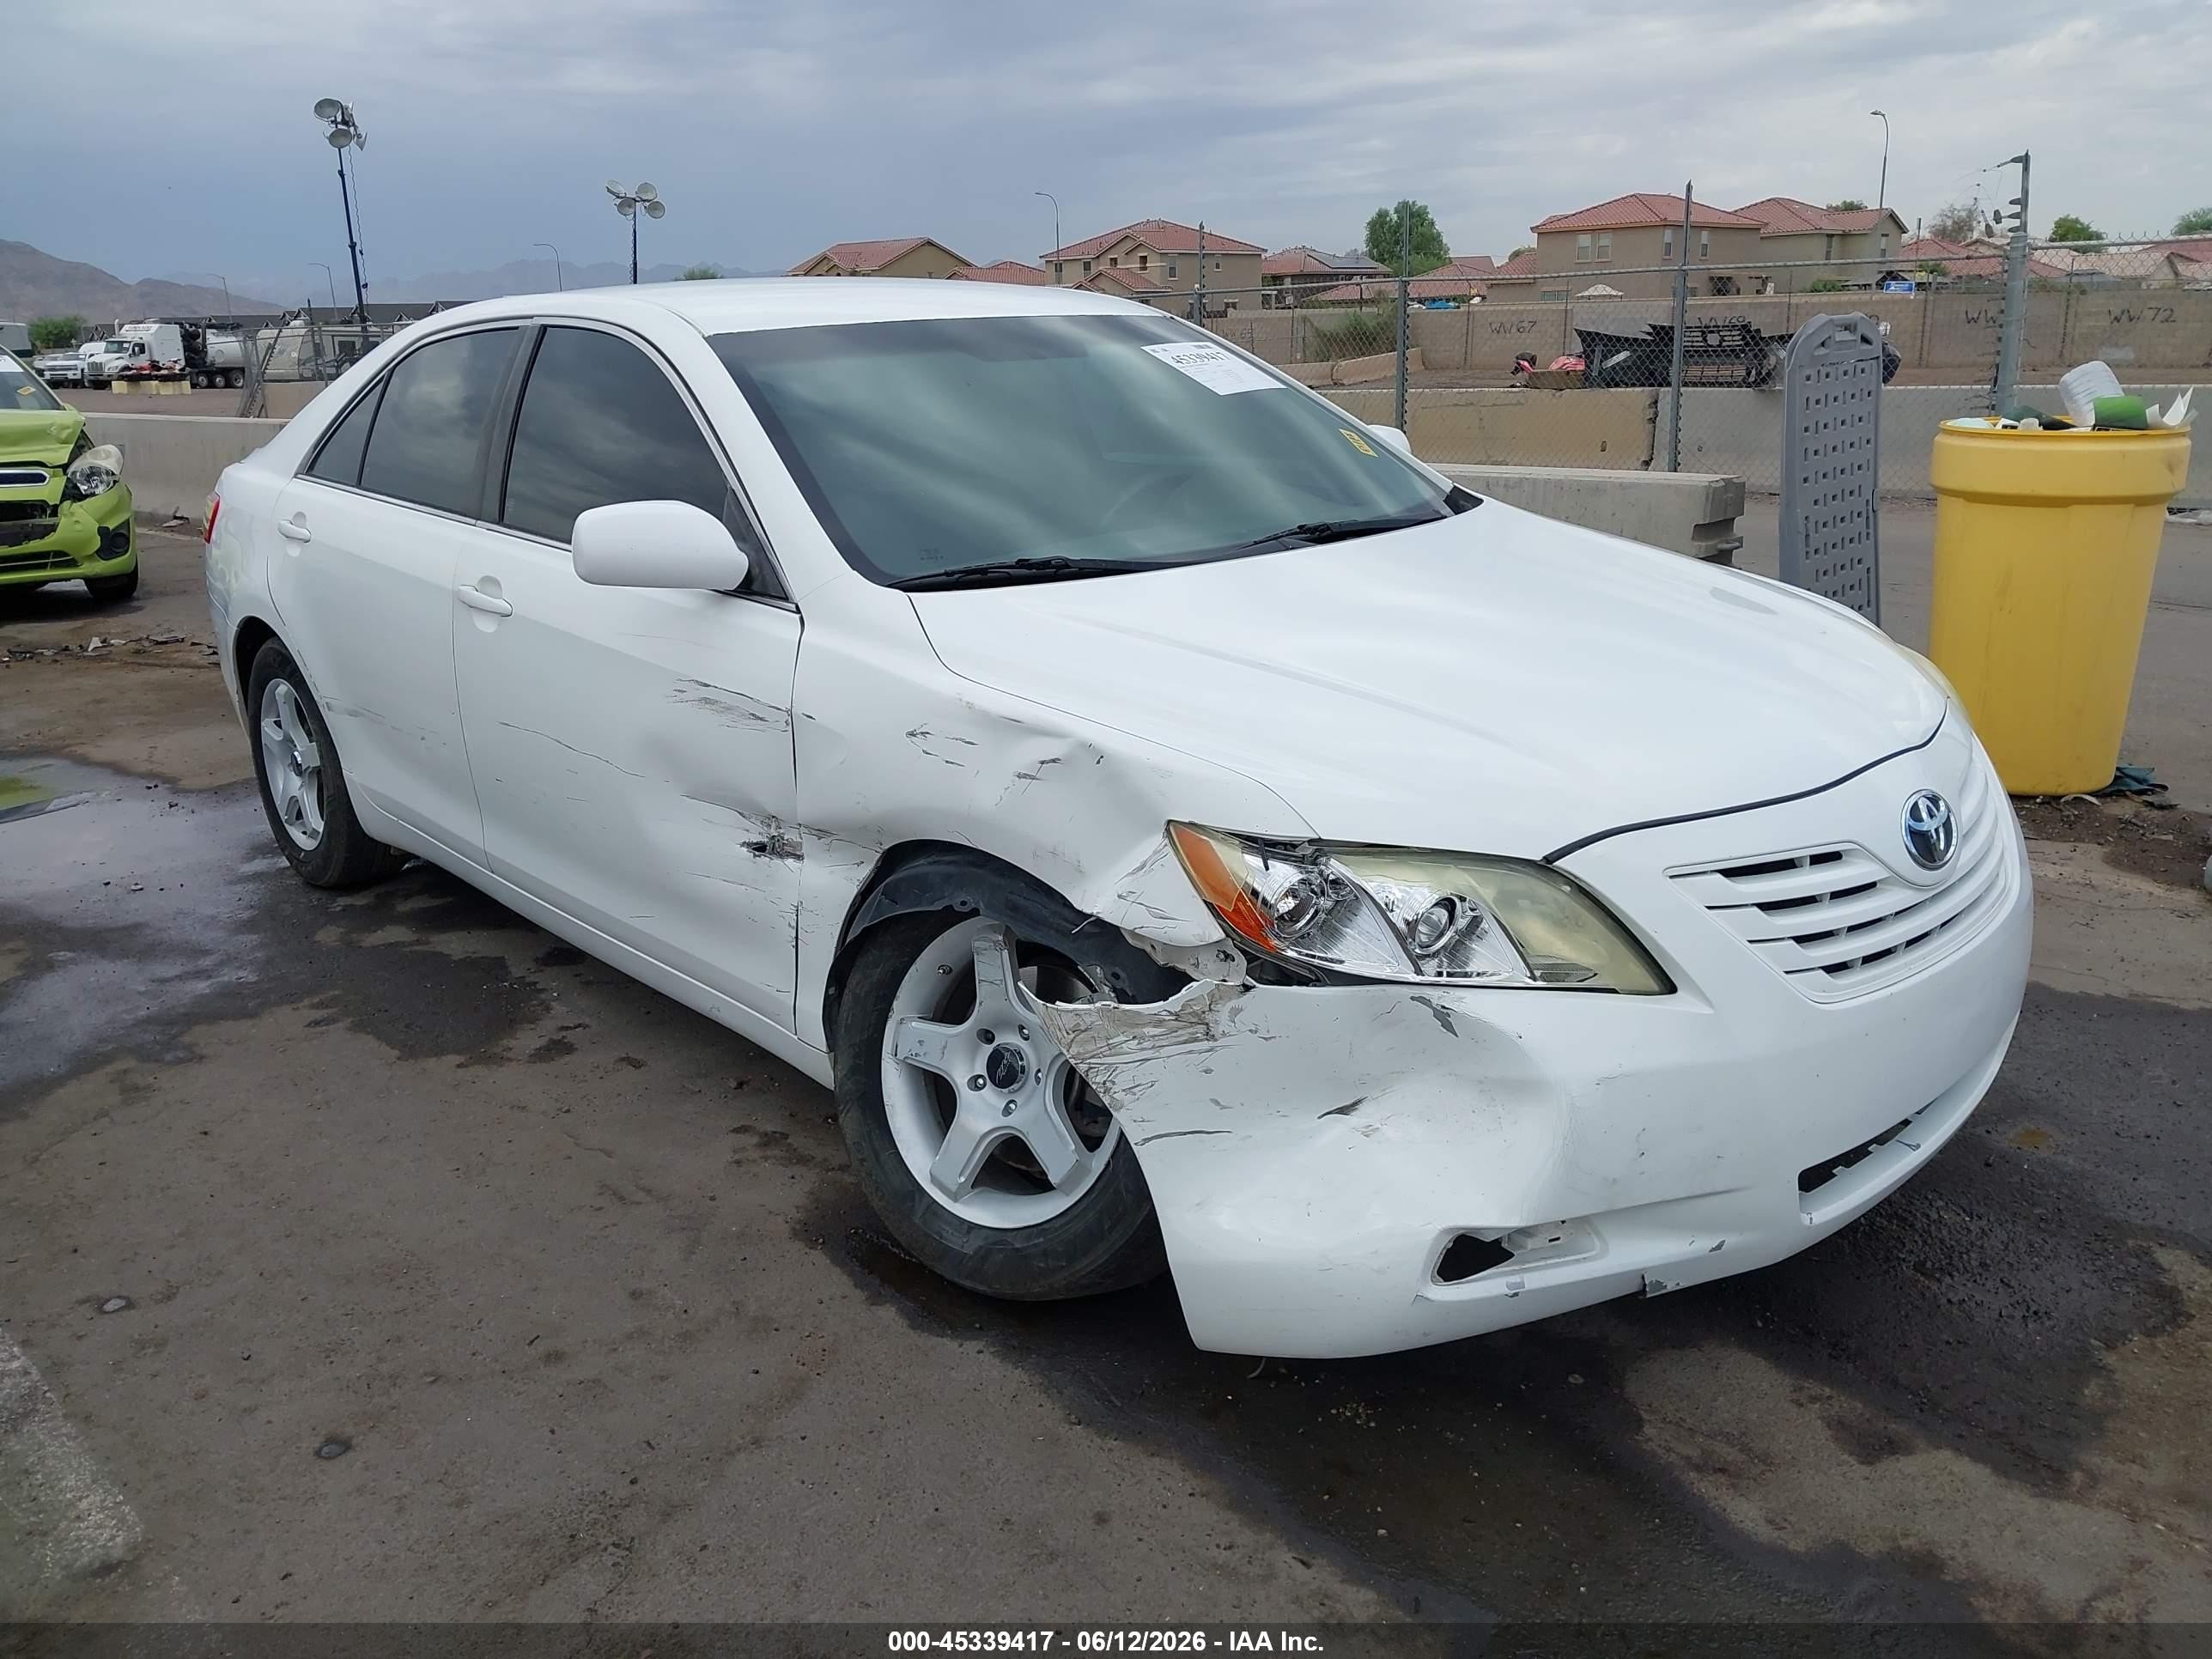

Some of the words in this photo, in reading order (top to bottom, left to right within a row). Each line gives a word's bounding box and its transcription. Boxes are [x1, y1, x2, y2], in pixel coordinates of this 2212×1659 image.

[2108, 308, 2144, 325] WW
[2147, 307, 2177, 323] 72
[1489, 321, 1513, 334] WW
[1516, 320, 1537, 333] 67
[1170, 351, 1231, 365] 45339417
